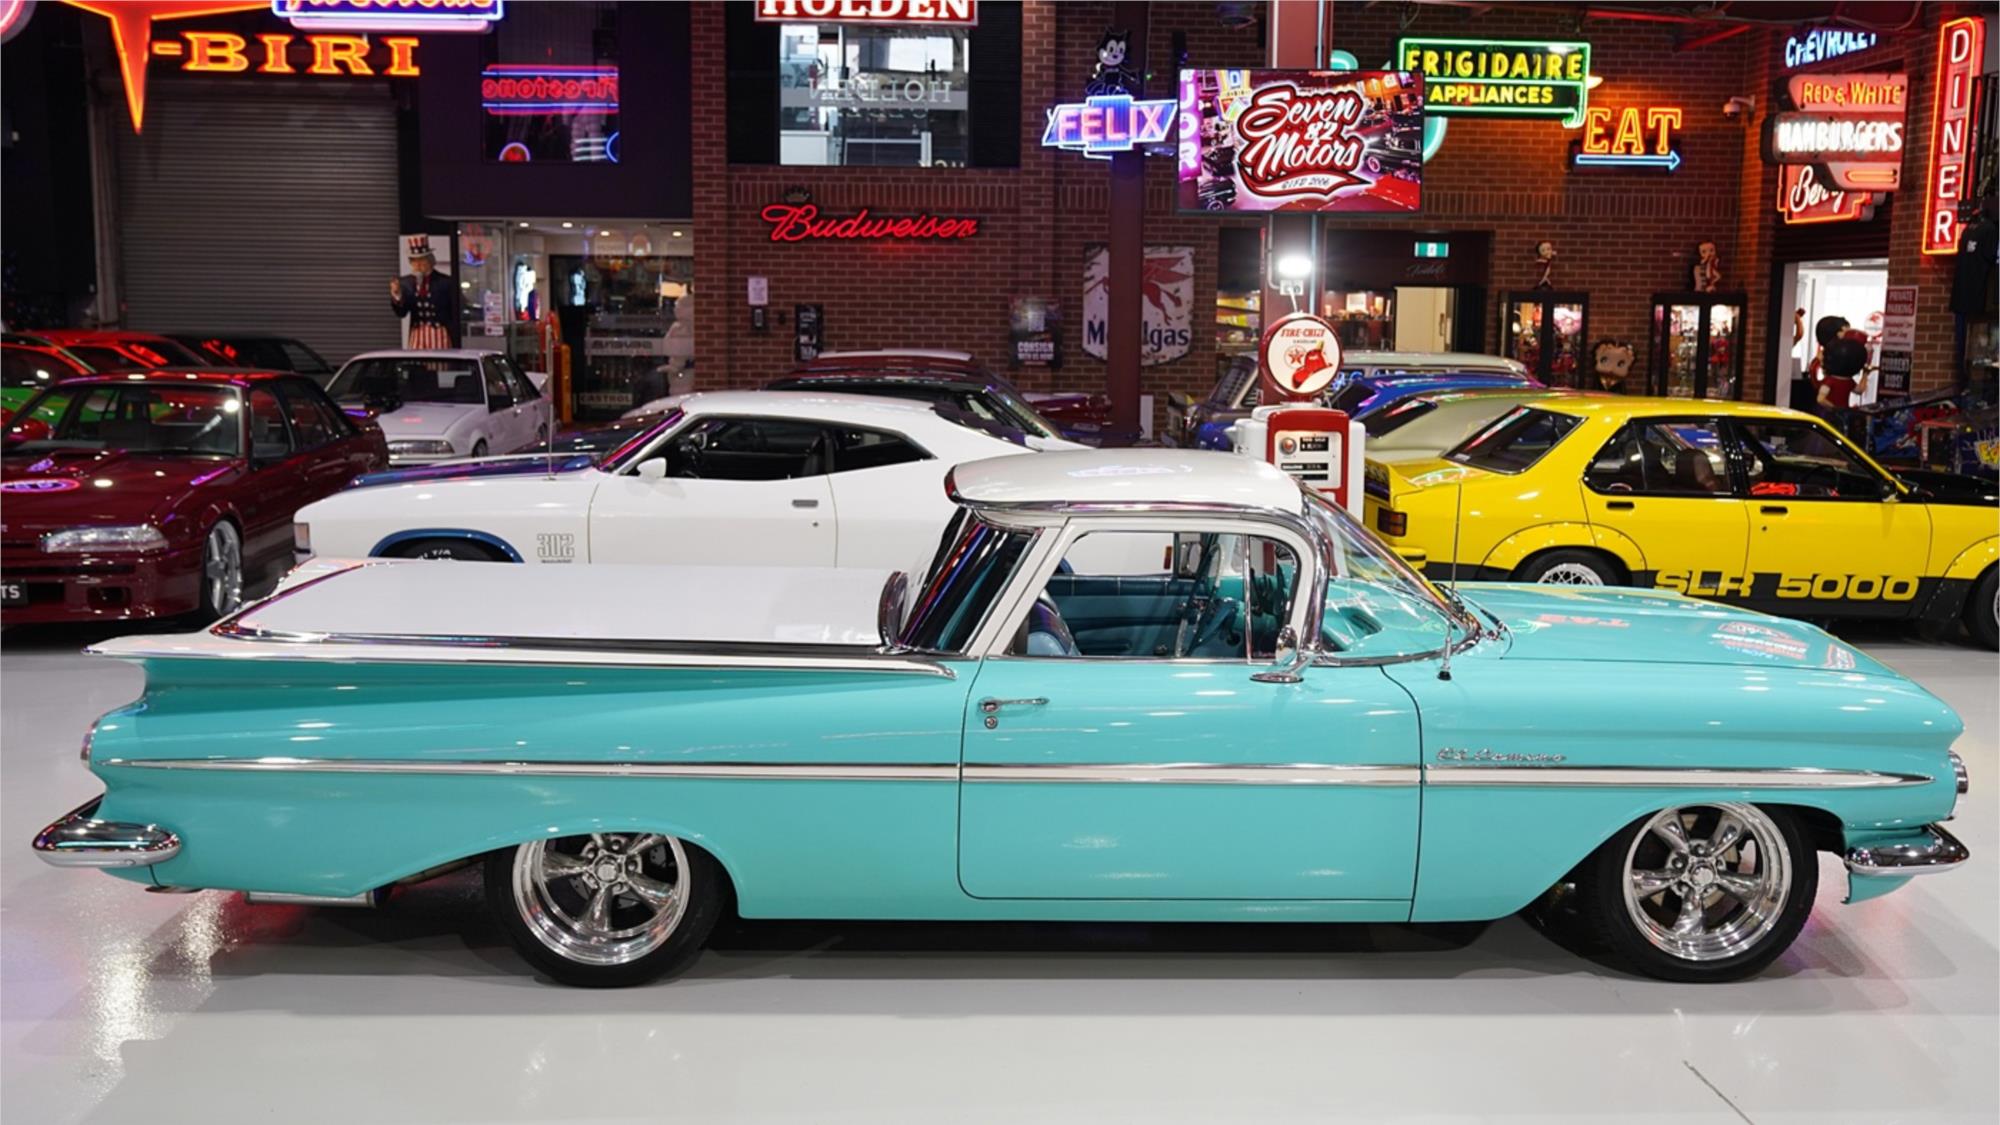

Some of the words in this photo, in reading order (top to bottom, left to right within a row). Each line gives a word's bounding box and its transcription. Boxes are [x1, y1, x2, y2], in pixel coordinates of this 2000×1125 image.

[761, 0, 969, 19] HOLDEN
[1404, 50, 1583, 80] FRIGIDAIRE
[1429, 84, 1554, 105] APPLIANCES
[1803, 82, 1832, 104] RED
[1850, 81, 1901, 105] WHITE
[1057, 105, 1165, 142] FELIX
[1243, 90, 1355, 137] Seven
[1303, 121, 1338, 141] 82
[1583, 107, 1682, 155] EAT
[1777, 119, 1903, 153] HAMBURGERS
[1933, 28, 1970, 244] DINER
[1245, 132, 1356, 178] Motors
[761, 203, 977, 241] Budweiser
[1086, 320, 1190, 353] Mlgas
[536, 533, 576, 558] 302
[1653, 569, 1755, 597] SLR
[1775, 573, 1919, 600] 5000
